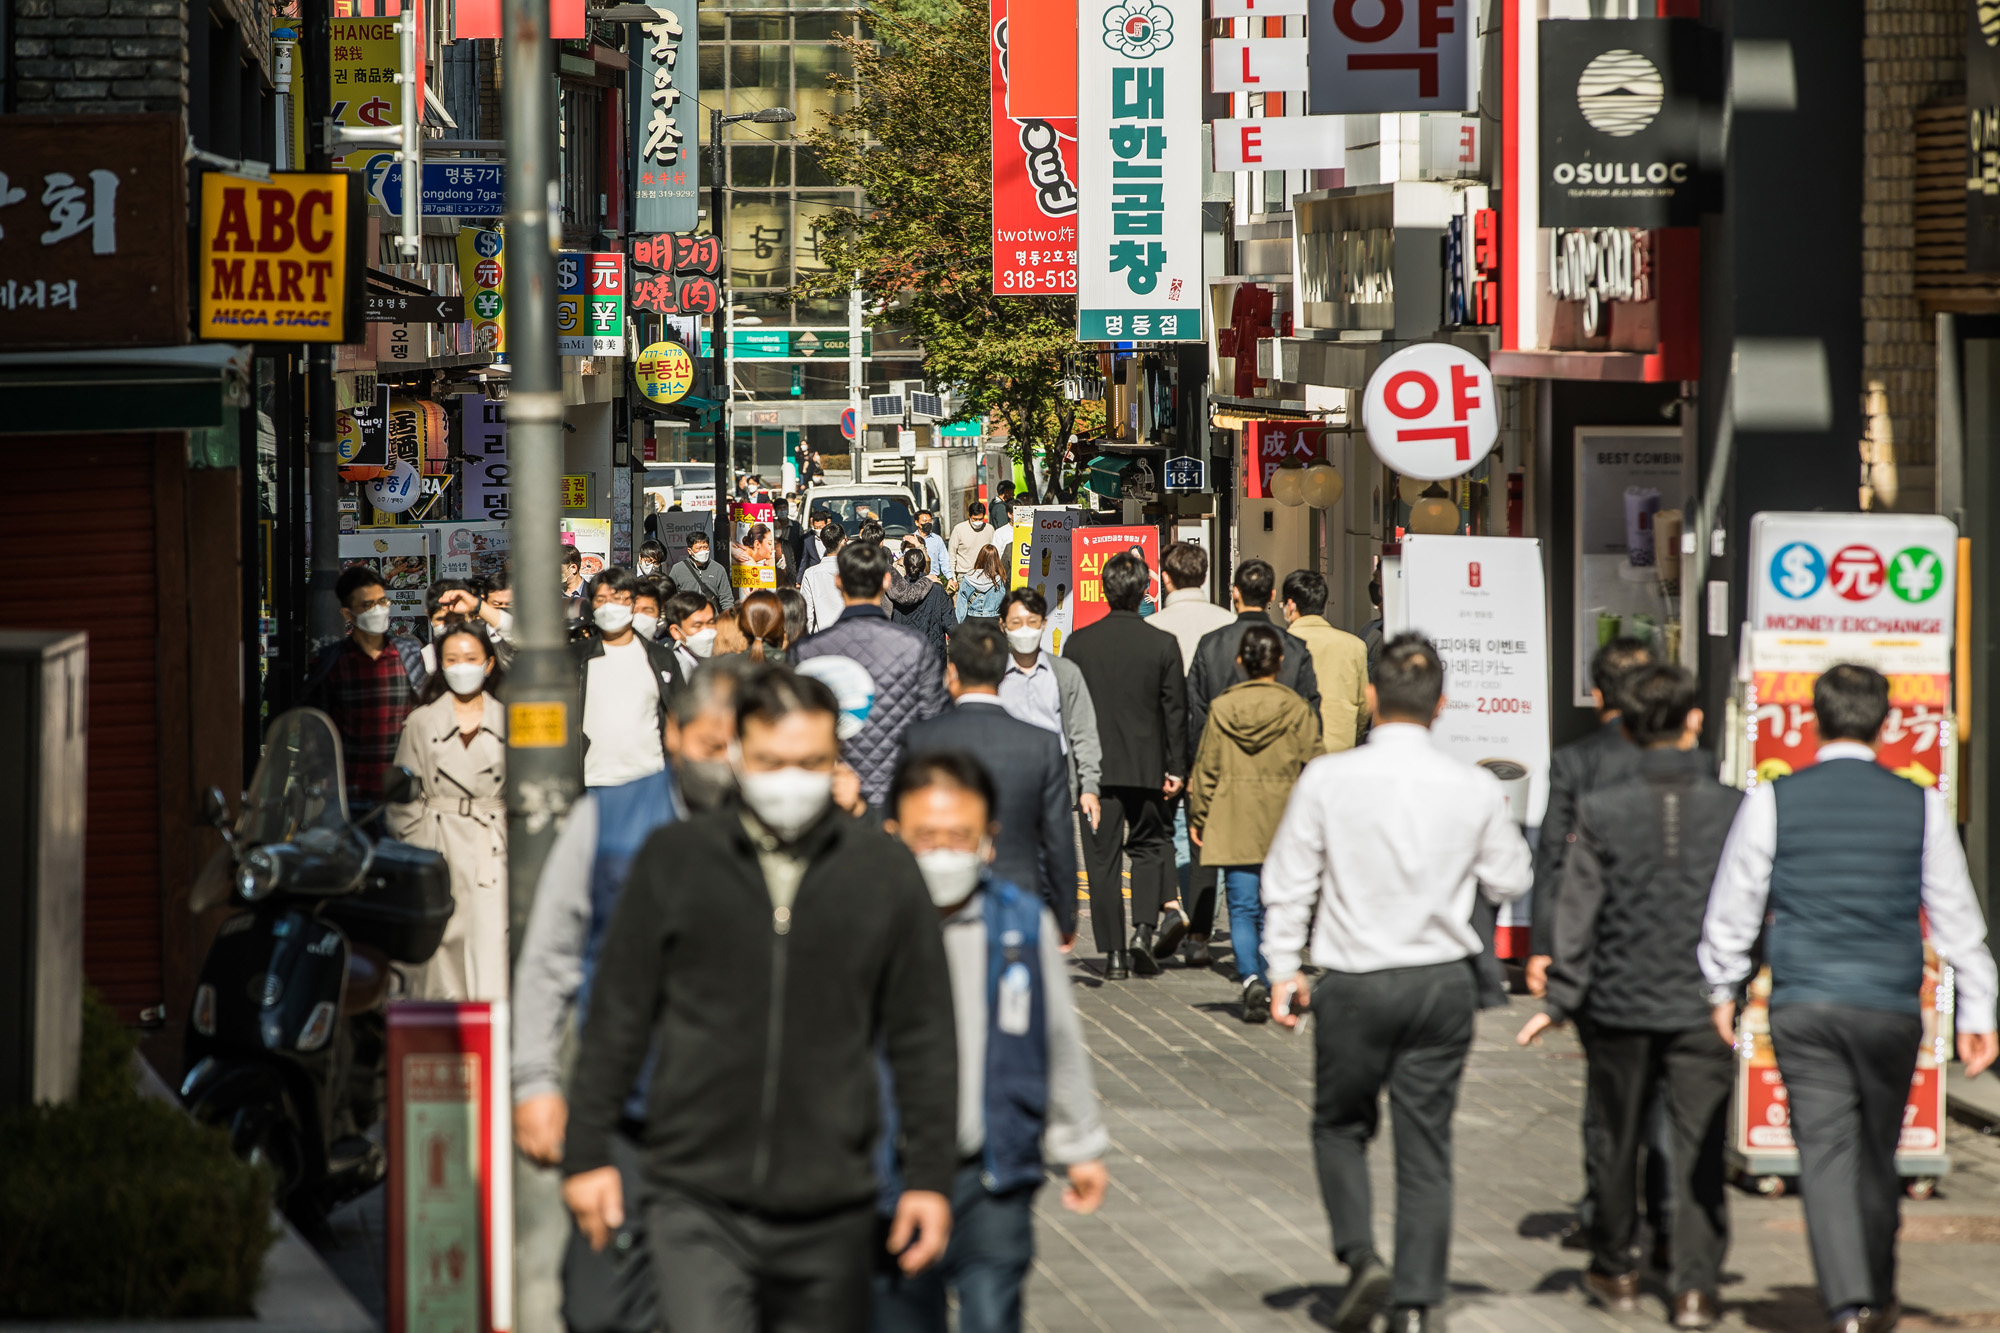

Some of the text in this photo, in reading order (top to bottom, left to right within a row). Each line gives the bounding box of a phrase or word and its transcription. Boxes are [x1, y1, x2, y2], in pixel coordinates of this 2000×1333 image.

[445, 168, 512, 185] 명동7가
[1109, 66, 1168, 296] 대한곱창
[1553, 162, 1688, 185] OSULLOC
[658, 190, 696, 199] 319-9292
[212, 187, 333, 254] ABC
[634, 233, 719, 272] 明洞
[1015, 250, 1077, 266] 명동2호점
[211, 259, 332, 302] MART
[591, 261, 619, 289] 元
[212, 308, 331, 327] MEGA STAGE
[1105, 315, 1178, 335] 명동점
[643, 349, 683, 358] 777-4778
[638, 359, 690, 381] 부동산
[646, 381, 686, 397] 플러스
[1383, 364, 1480, 461] 약
[1262, 431, 1315, 459] 成人
[1169, 472, 1199, 485] 18-1
[757, 509, 771, 522] 4F
[1040, 534, 1053, 543] BEST
[1834, 547, 1880, 596] 元
[1486, 639, 1528, 654] 이벤트
[1477, 697, 1532, 714] 2,000원
